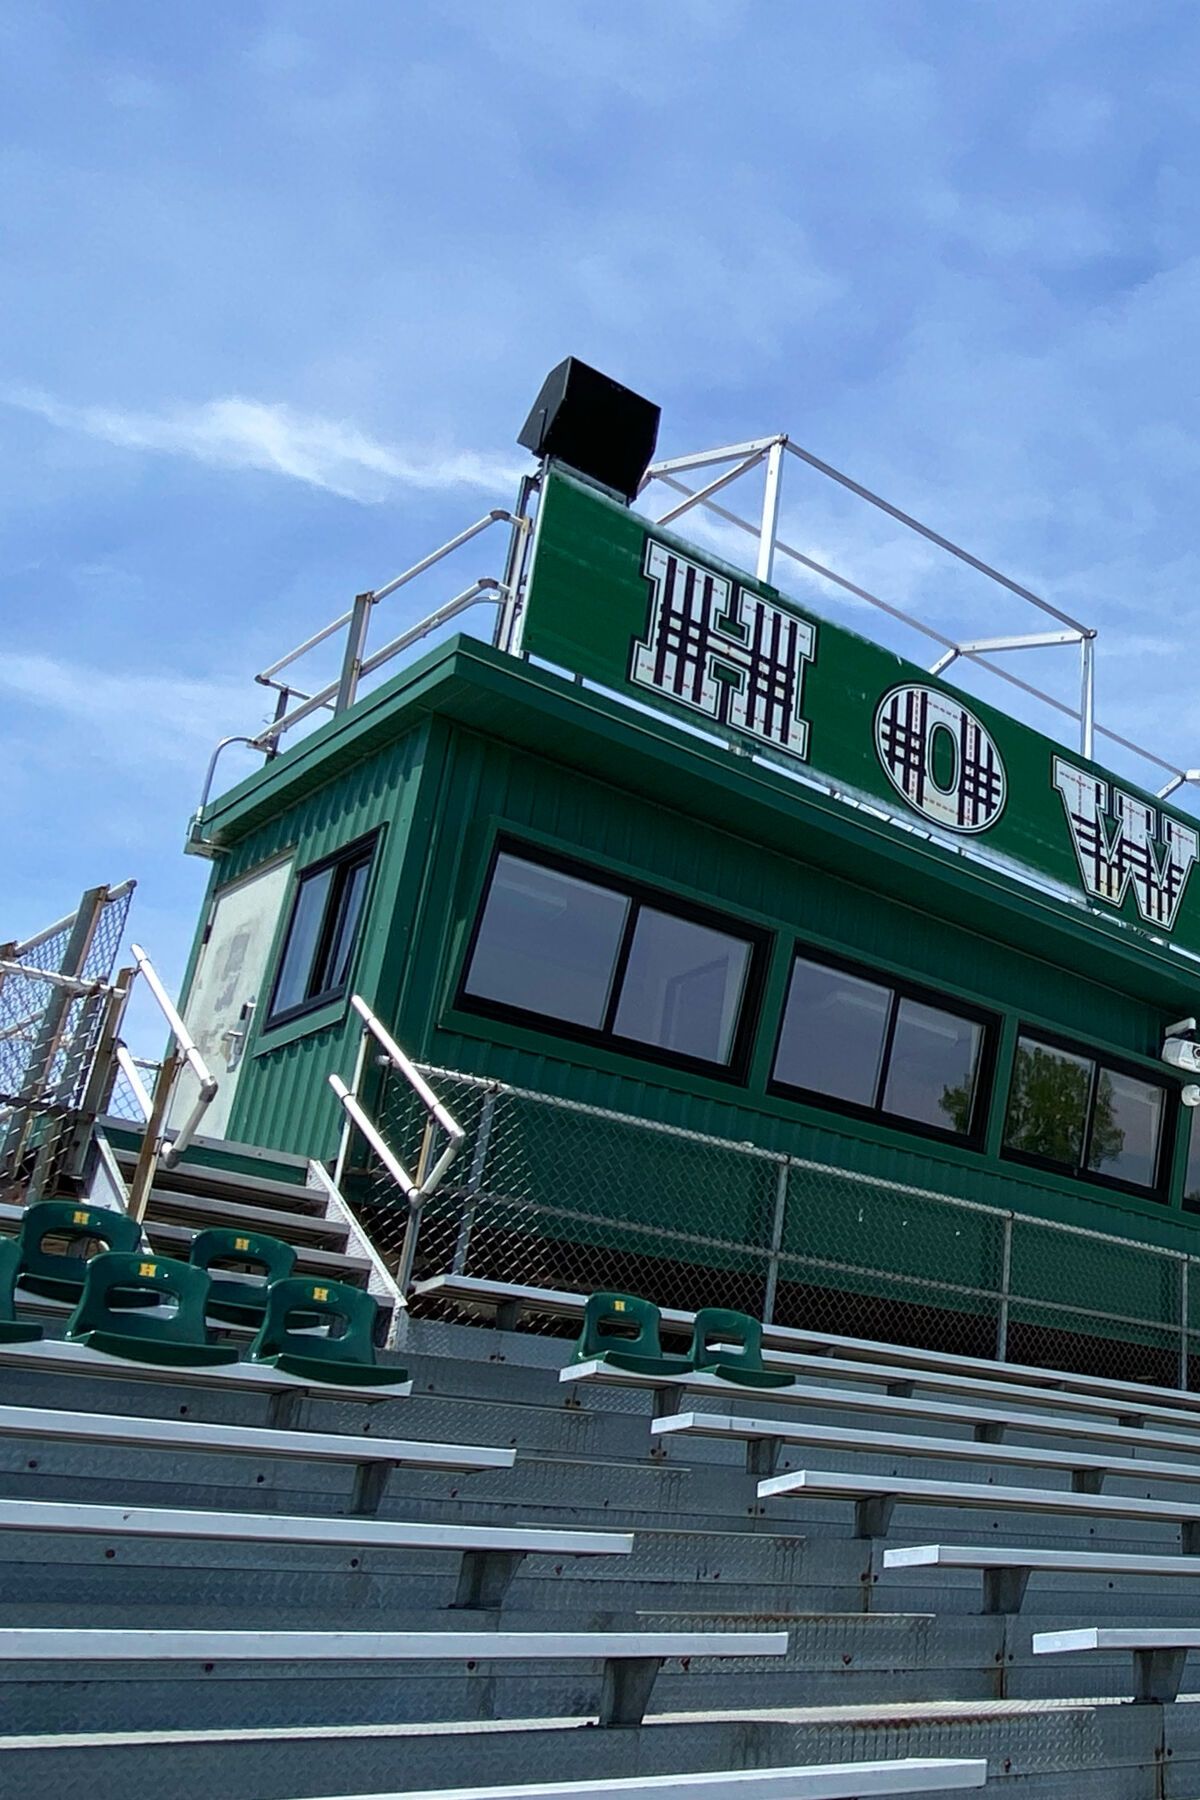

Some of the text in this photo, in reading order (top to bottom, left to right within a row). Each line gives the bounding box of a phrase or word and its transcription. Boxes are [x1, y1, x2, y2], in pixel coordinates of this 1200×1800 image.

[73, 1211, 90, 1224] H
[235, 1238, 249, 1250] H
[139, 1263, 157, 1277] H
[313, 1287, 329, 1301] H
